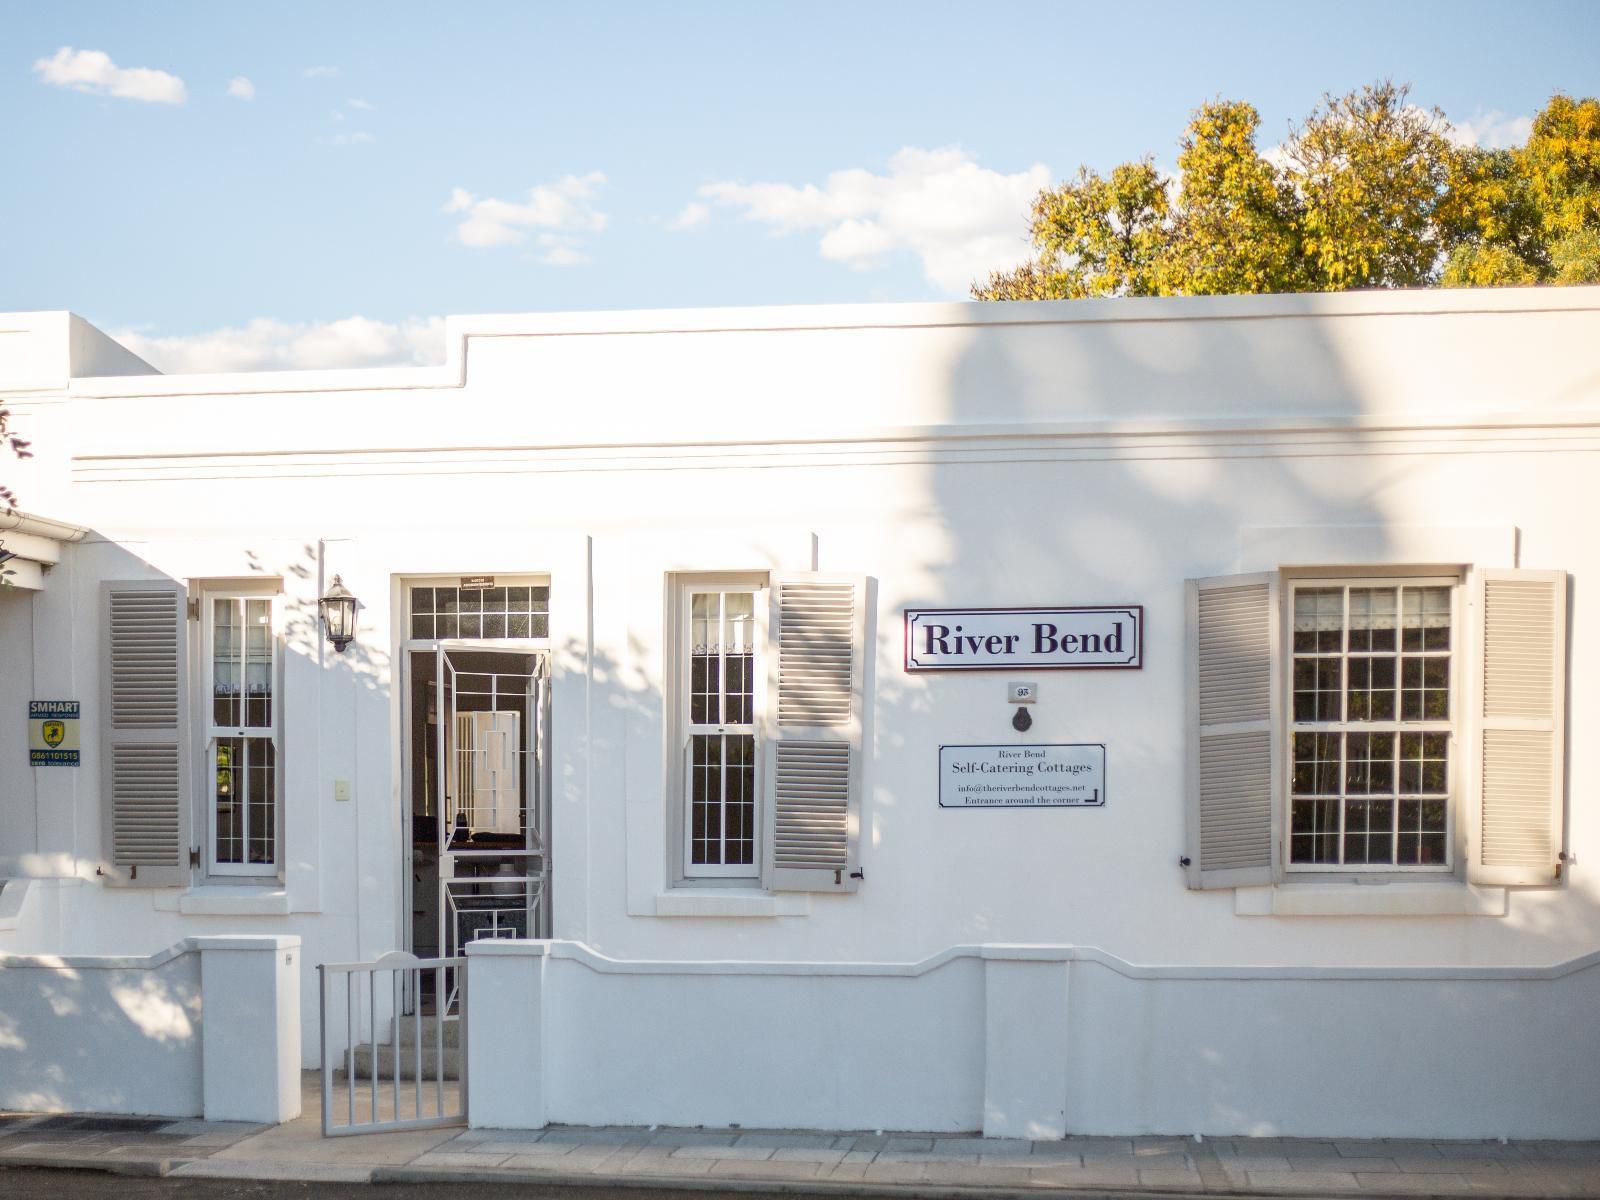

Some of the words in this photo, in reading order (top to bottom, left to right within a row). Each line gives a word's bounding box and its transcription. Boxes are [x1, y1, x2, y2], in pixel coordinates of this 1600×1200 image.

[923, 624, 1019, 655] River
[1031, 622, 1125, 654] Bend
[31, 702, 79, 712] SMHART
[998, 750, 1022, 758] River
[1024, 750, 1046, 758] Bend
[952, 762, 1034, 776] Self-Catering
[1037, 761, 1092, 775] Cottages
[958, 783, 1086, 793] info@theriverbendcottages.net
[965, 797, 1004, 805] Entrance
[1005, 796, 1036, 804] around
[1037, 796, 1051, 804] the
